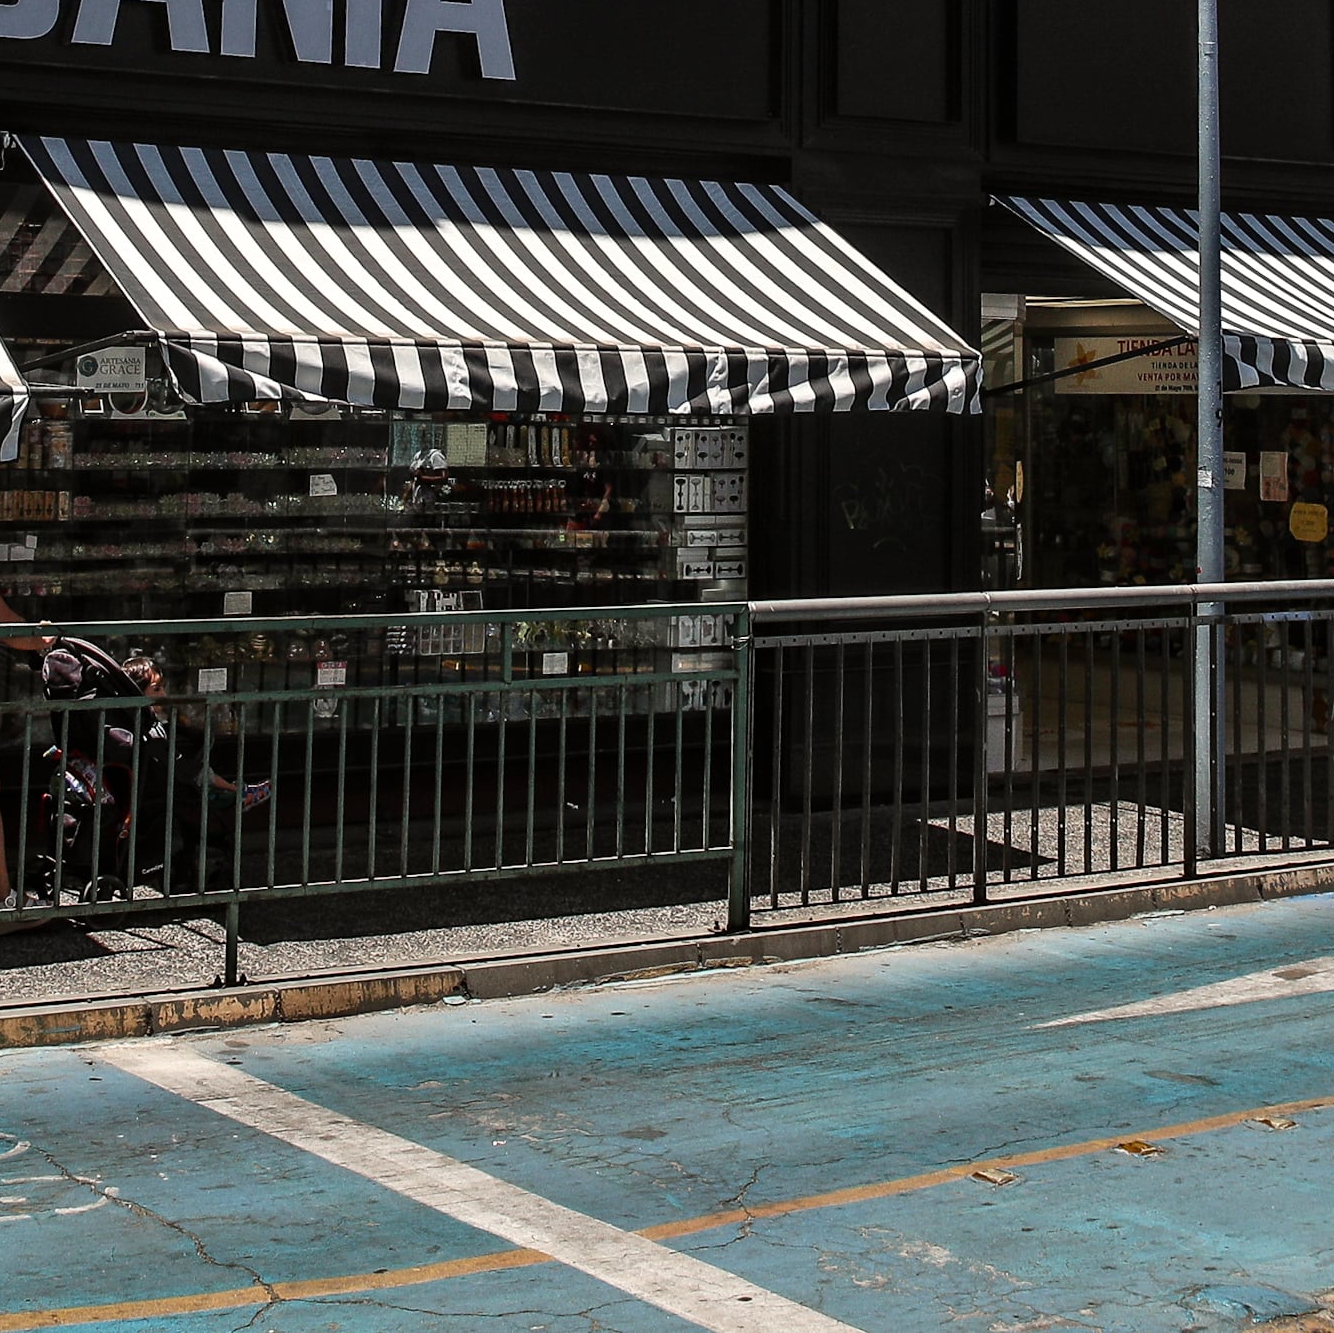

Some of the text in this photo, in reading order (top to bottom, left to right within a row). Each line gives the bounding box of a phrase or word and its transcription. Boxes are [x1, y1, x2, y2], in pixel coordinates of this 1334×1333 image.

[1117, 340, 1173, 357] TIENDA
[99, 365, 141, 375] GRACE
[1137, 373, 1163, 381] VENTA
[1165, 373, 1181, 381] POR
